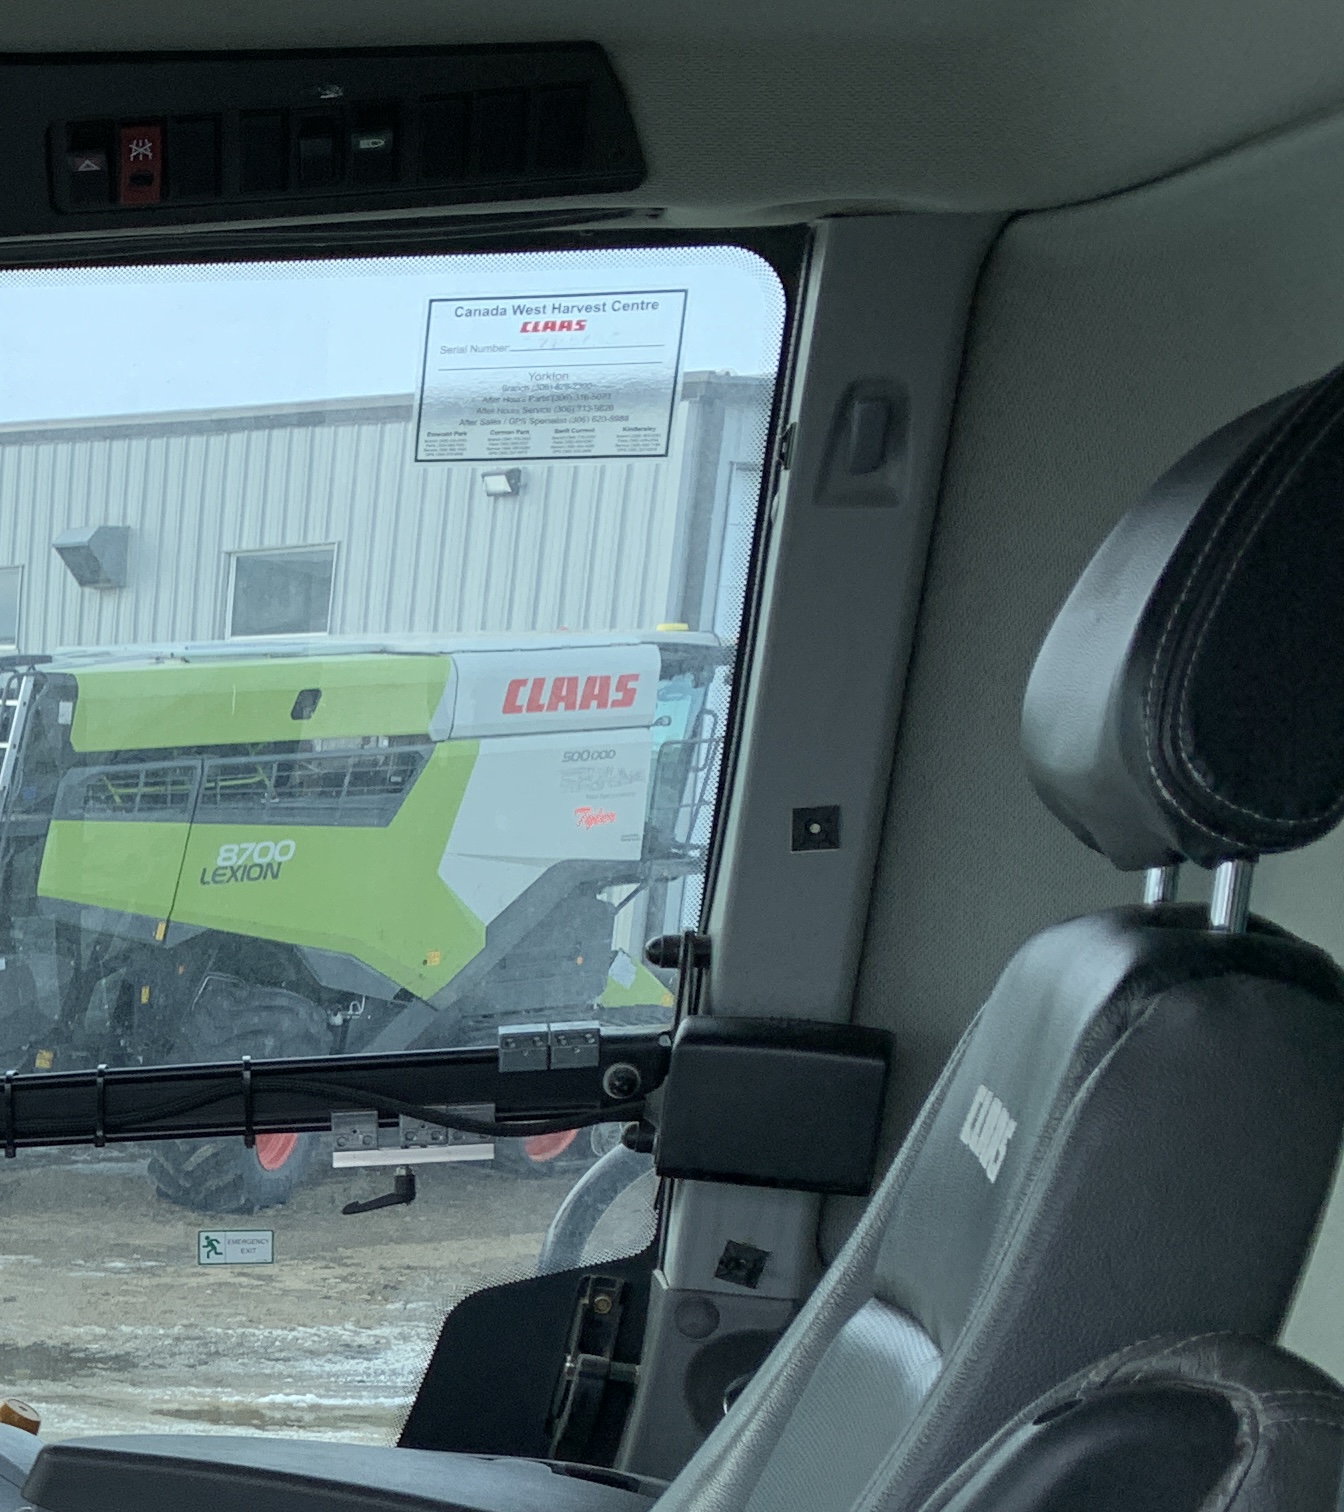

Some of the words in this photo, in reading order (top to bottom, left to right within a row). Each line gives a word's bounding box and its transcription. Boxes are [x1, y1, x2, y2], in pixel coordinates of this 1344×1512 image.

[454, 305, 507, 318] Canada
[512, 304, 547, 316] West
[552, 303, 607, 315] Harvest
[611, 300, 660, 312] Centre
[519, 319, 588, 333] CLAAS
[439, 345, 468, 355] Serial
[528, 370, 569, 382] Yorkton
[482, 394, 501, 403] After
[477, 406, 496, 415] After
[459, 418, 478, 427] After
[480, 417, 501, 426] Sales
[502, 673, 641, 715] CLAAS
[216, 838, 296, 867] 8700
[200, 861, 283, 885] LEXION
[227, 1238, 269, 1246] EMERGENCY
[240, 1247, 257, 1255] EXIT
